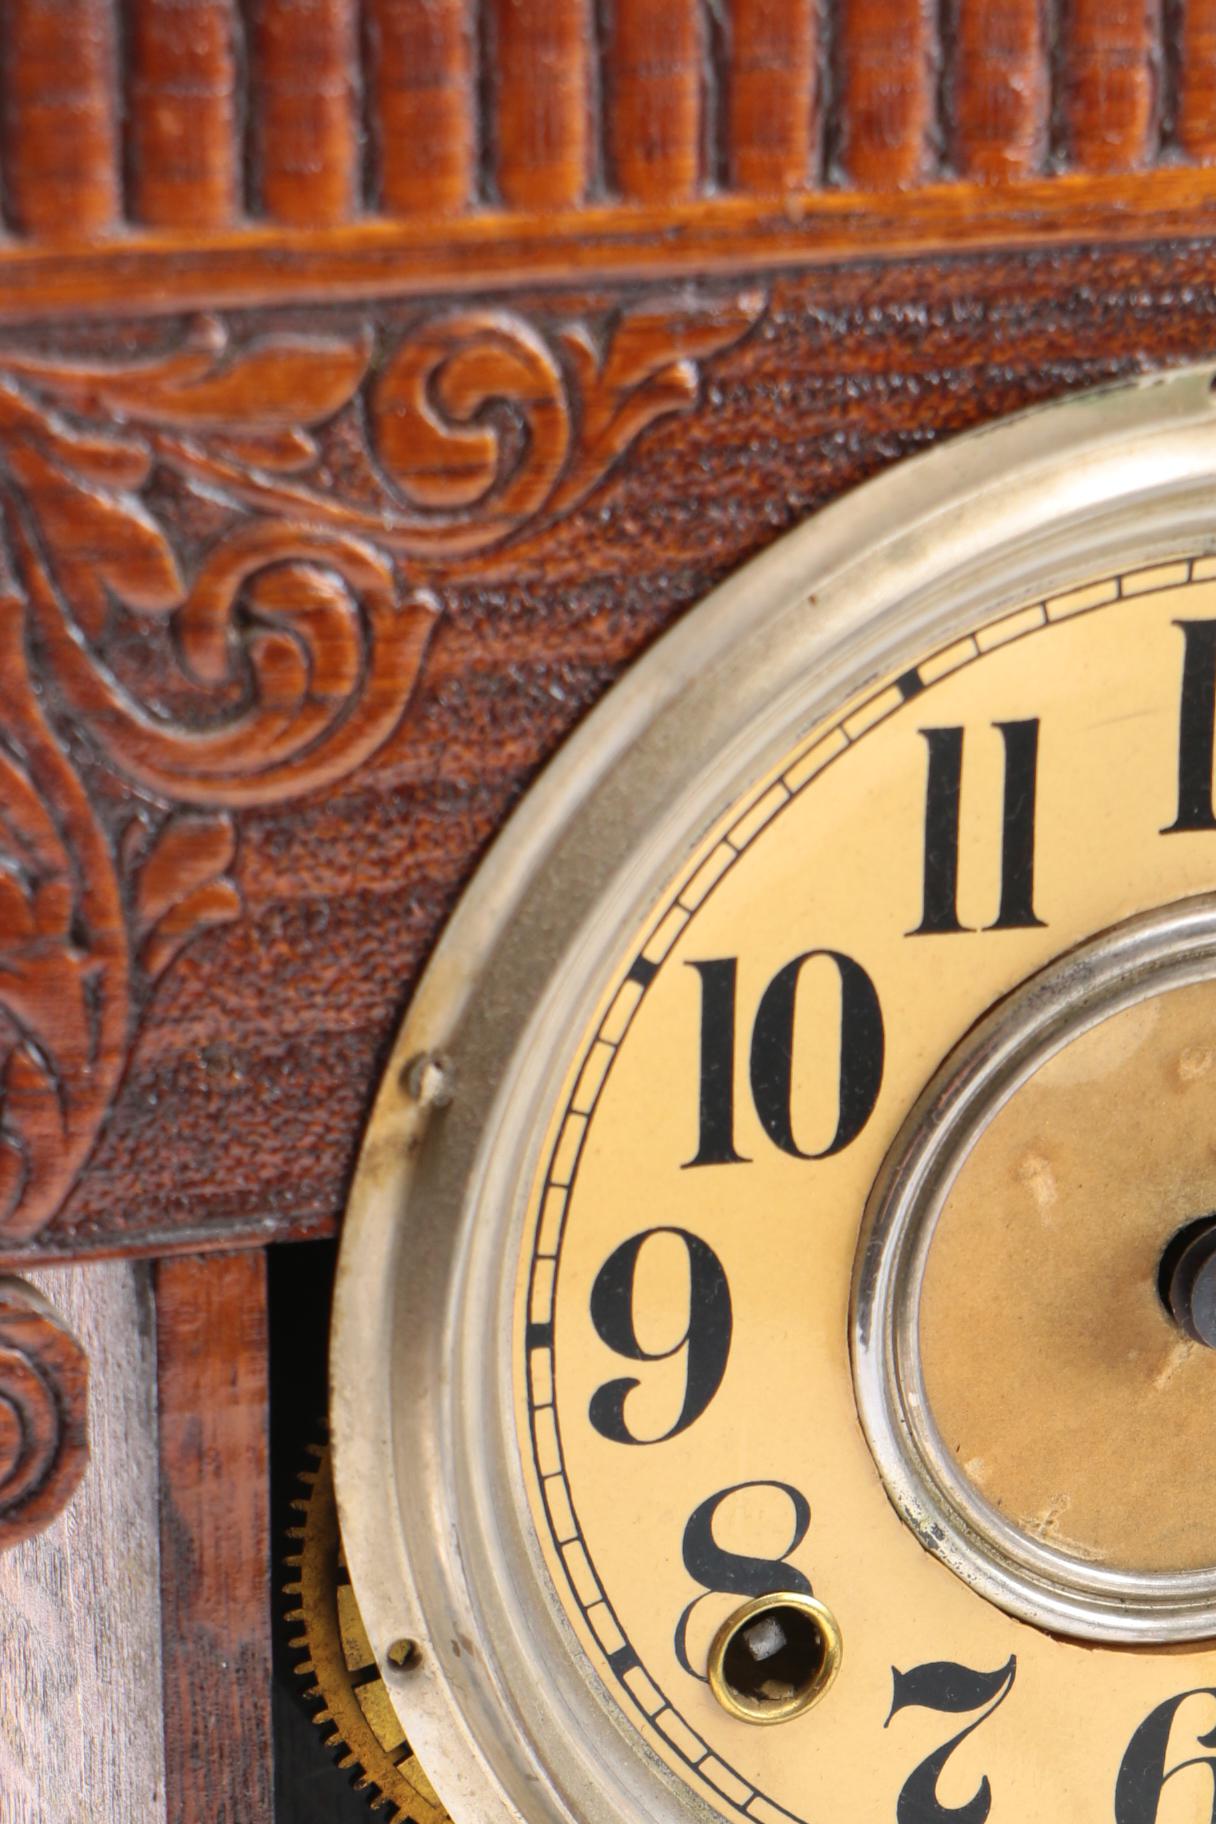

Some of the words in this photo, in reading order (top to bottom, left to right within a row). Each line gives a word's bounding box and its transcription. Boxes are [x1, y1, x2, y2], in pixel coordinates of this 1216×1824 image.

[905, 719, 1048, 937] 11
[682, 950, 885, 1169] 10
[589, 1227, 733, 1445] 9
[675, 1480, 815, 1688] 8
